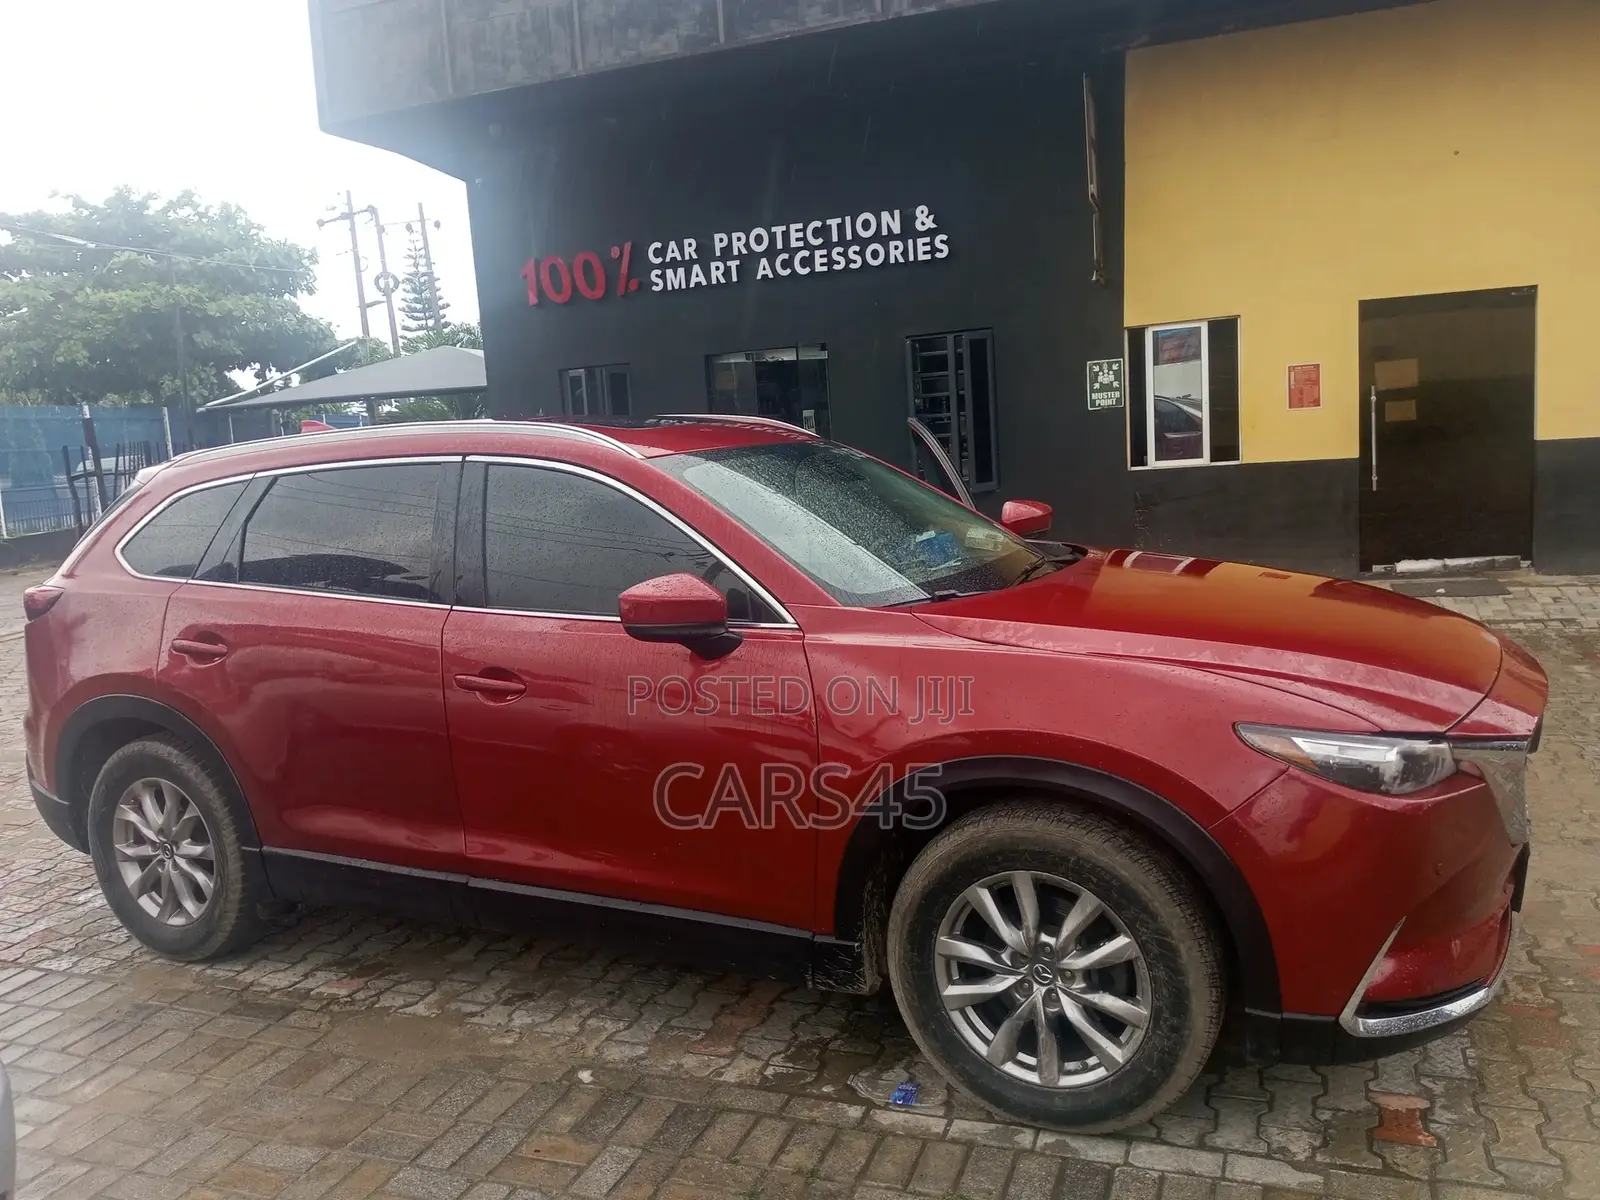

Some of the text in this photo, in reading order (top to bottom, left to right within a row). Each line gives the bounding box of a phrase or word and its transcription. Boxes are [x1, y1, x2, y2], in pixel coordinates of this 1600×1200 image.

[647, 205, 938, 264] CAR PROTECTION &
[650, 234, 949, 292] SMART ACCESSORIES
[520, 240, 639, 306] 100%
[1091, 391, 1120, 400] MUSTER
[1095, 398, 1117, 407] POINT
